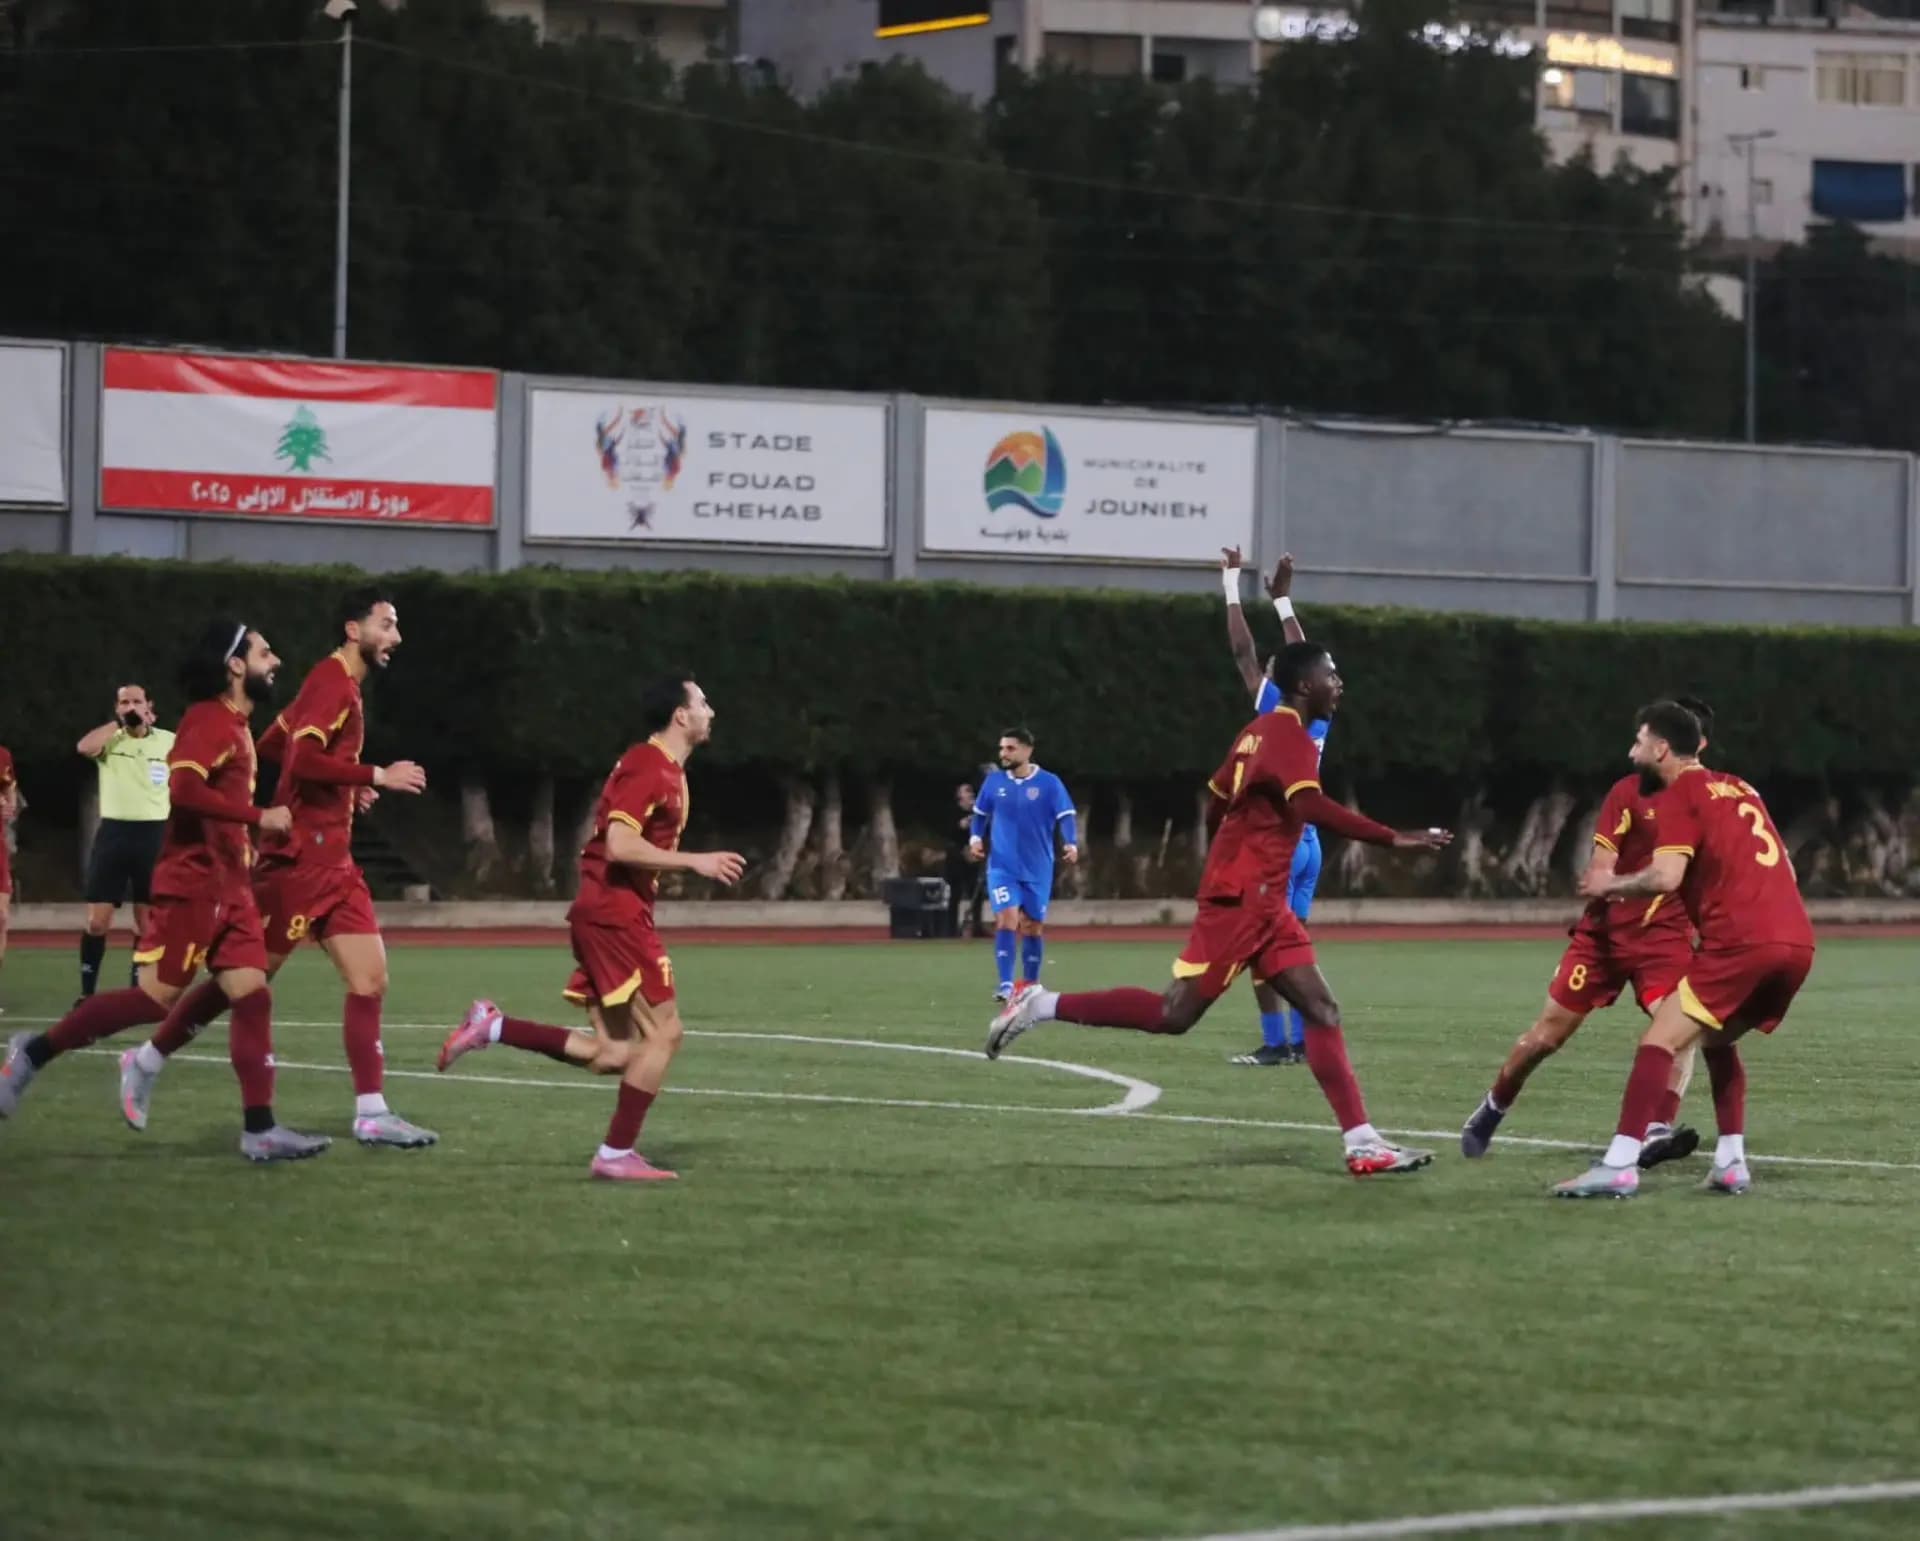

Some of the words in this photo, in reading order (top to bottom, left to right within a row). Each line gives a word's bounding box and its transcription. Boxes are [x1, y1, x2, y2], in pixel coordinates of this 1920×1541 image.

[708, 431, 813, 453] STADE
[708, 470, 816, 492] FOUAD
[290, 486, 365, 513] الاستقلال
[368, 488, 410, 517] دورة
[1085, 499, 1208, 521] JOUNIEH
[694, 500, 822, 522] CHEHAB
[1738, 802, 1780, 867] 3
[992, 886, 1011, 905] 15
[1568, 964, 1588, 991] 8
